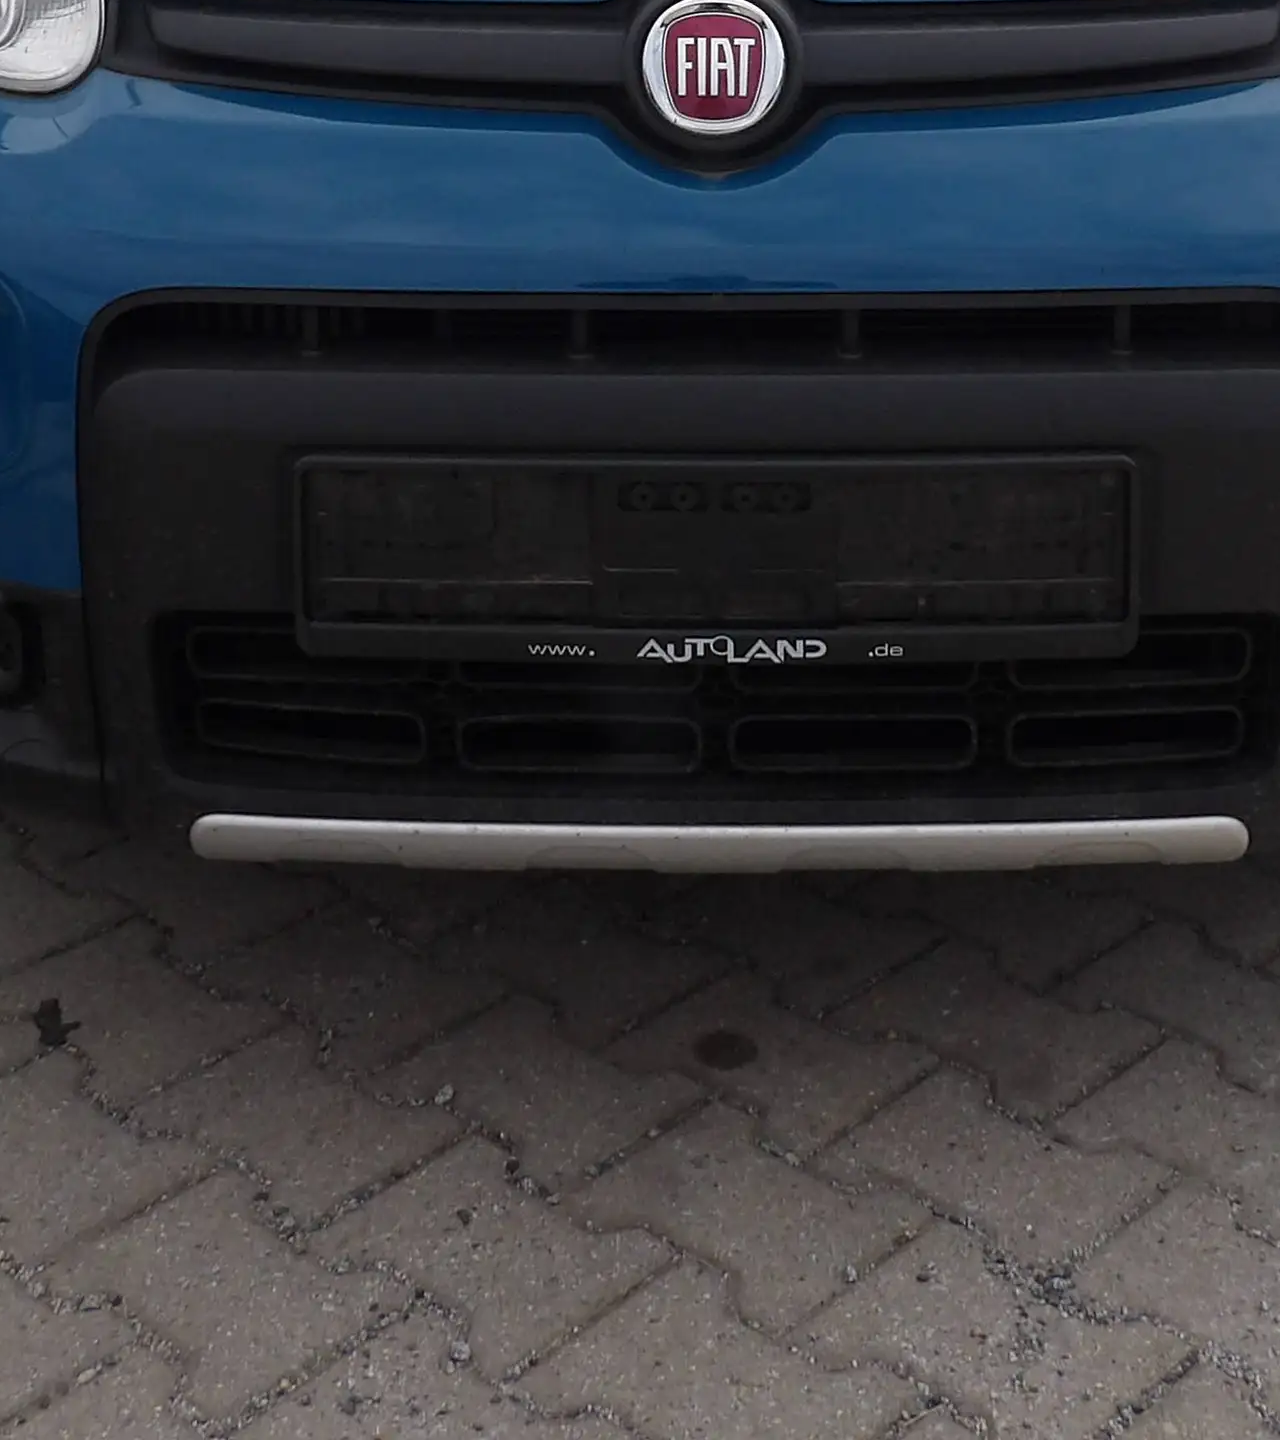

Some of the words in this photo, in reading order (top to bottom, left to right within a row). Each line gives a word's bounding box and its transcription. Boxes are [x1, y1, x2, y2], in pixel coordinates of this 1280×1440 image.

[676, 37, 756, 97] FIAT
[527, 642, 596, 657] www.
[637, 635, 828, 664] AUTOLAND
[867, 642, 904, 658] .de
